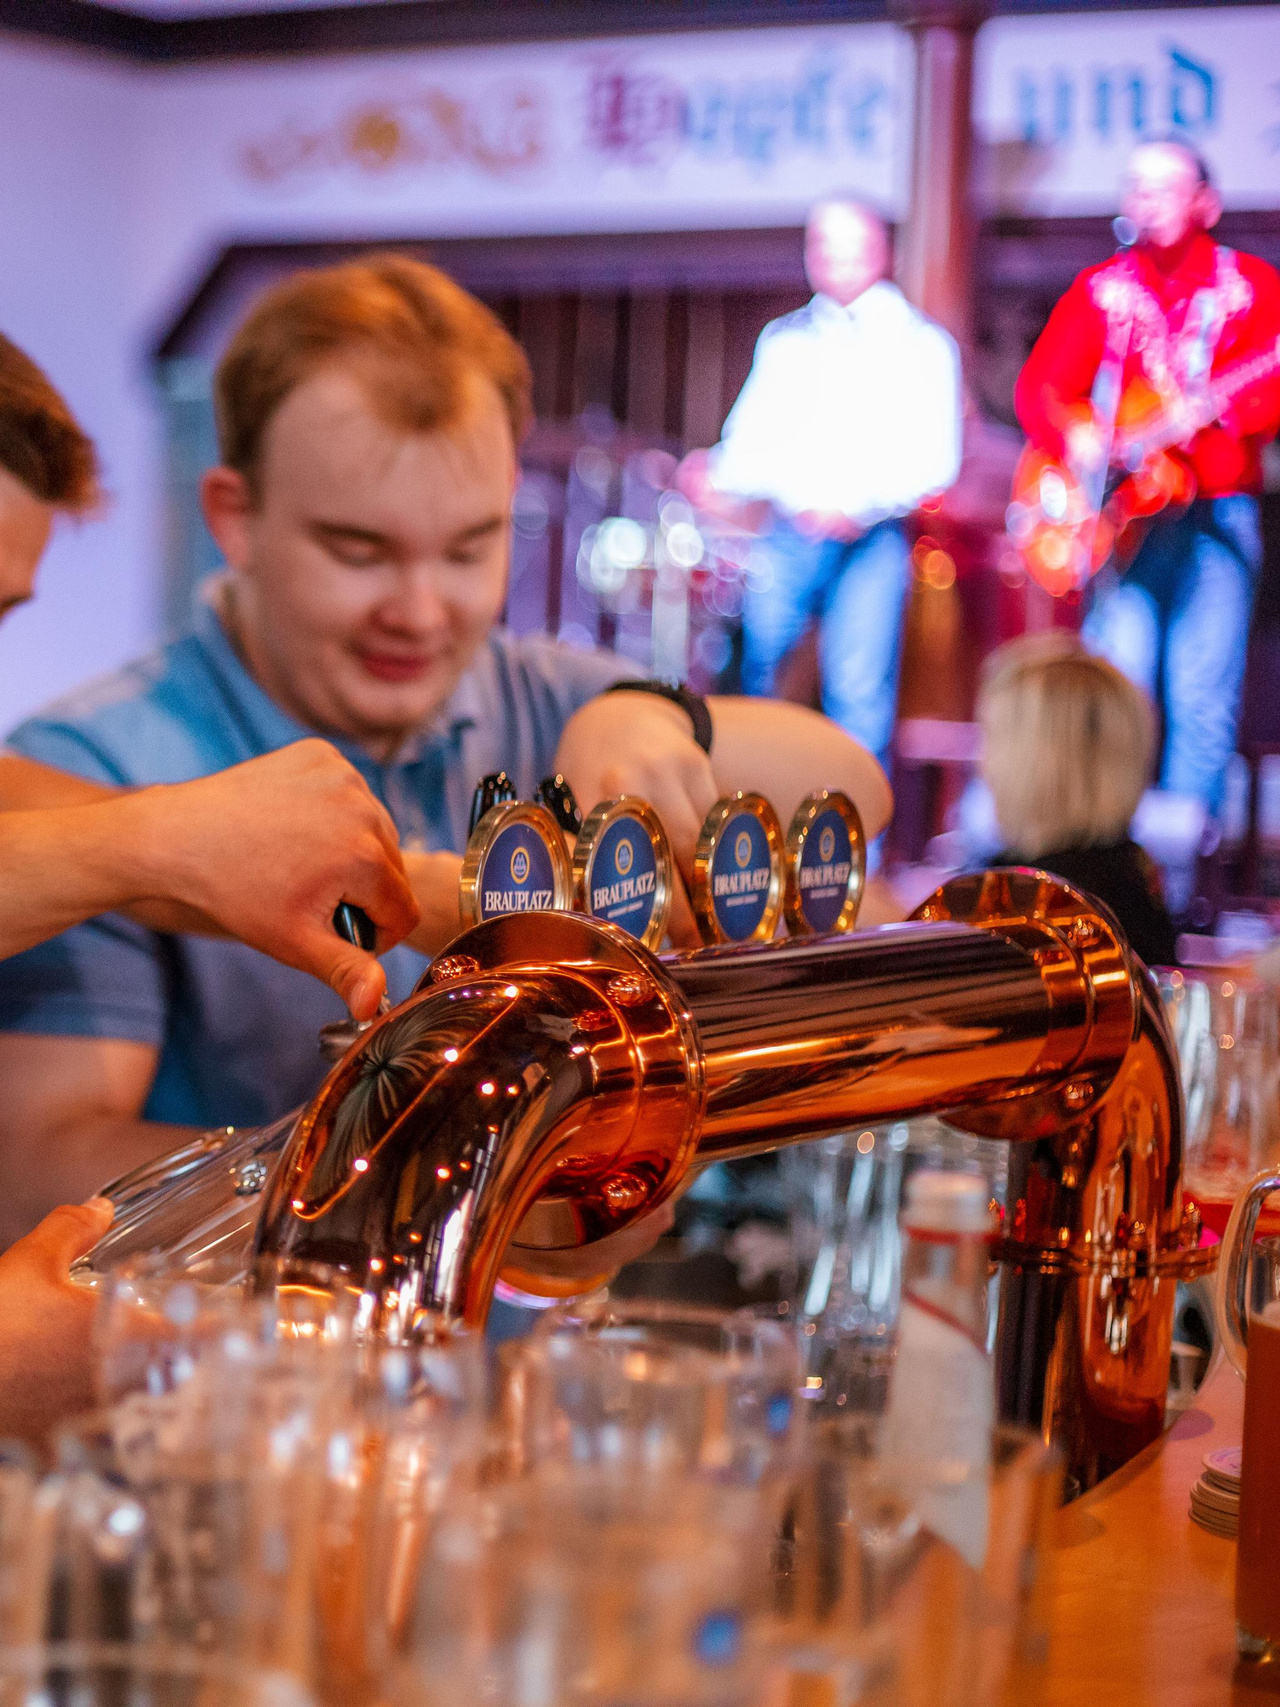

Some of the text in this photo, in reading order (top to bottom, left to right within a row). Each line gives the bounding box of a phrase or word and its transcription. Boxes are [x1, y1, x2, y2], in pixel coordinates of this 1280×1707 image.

[1014, 44, 1219, 142] und
[714, 867, 769, 896] BRAUPLATZ
[799, 862, 851, 889] BRAUPLATZ
[484, 890, 553, 911] BRAUPLATZ
[593, 871, 656, 910] BRAUPLATZ
